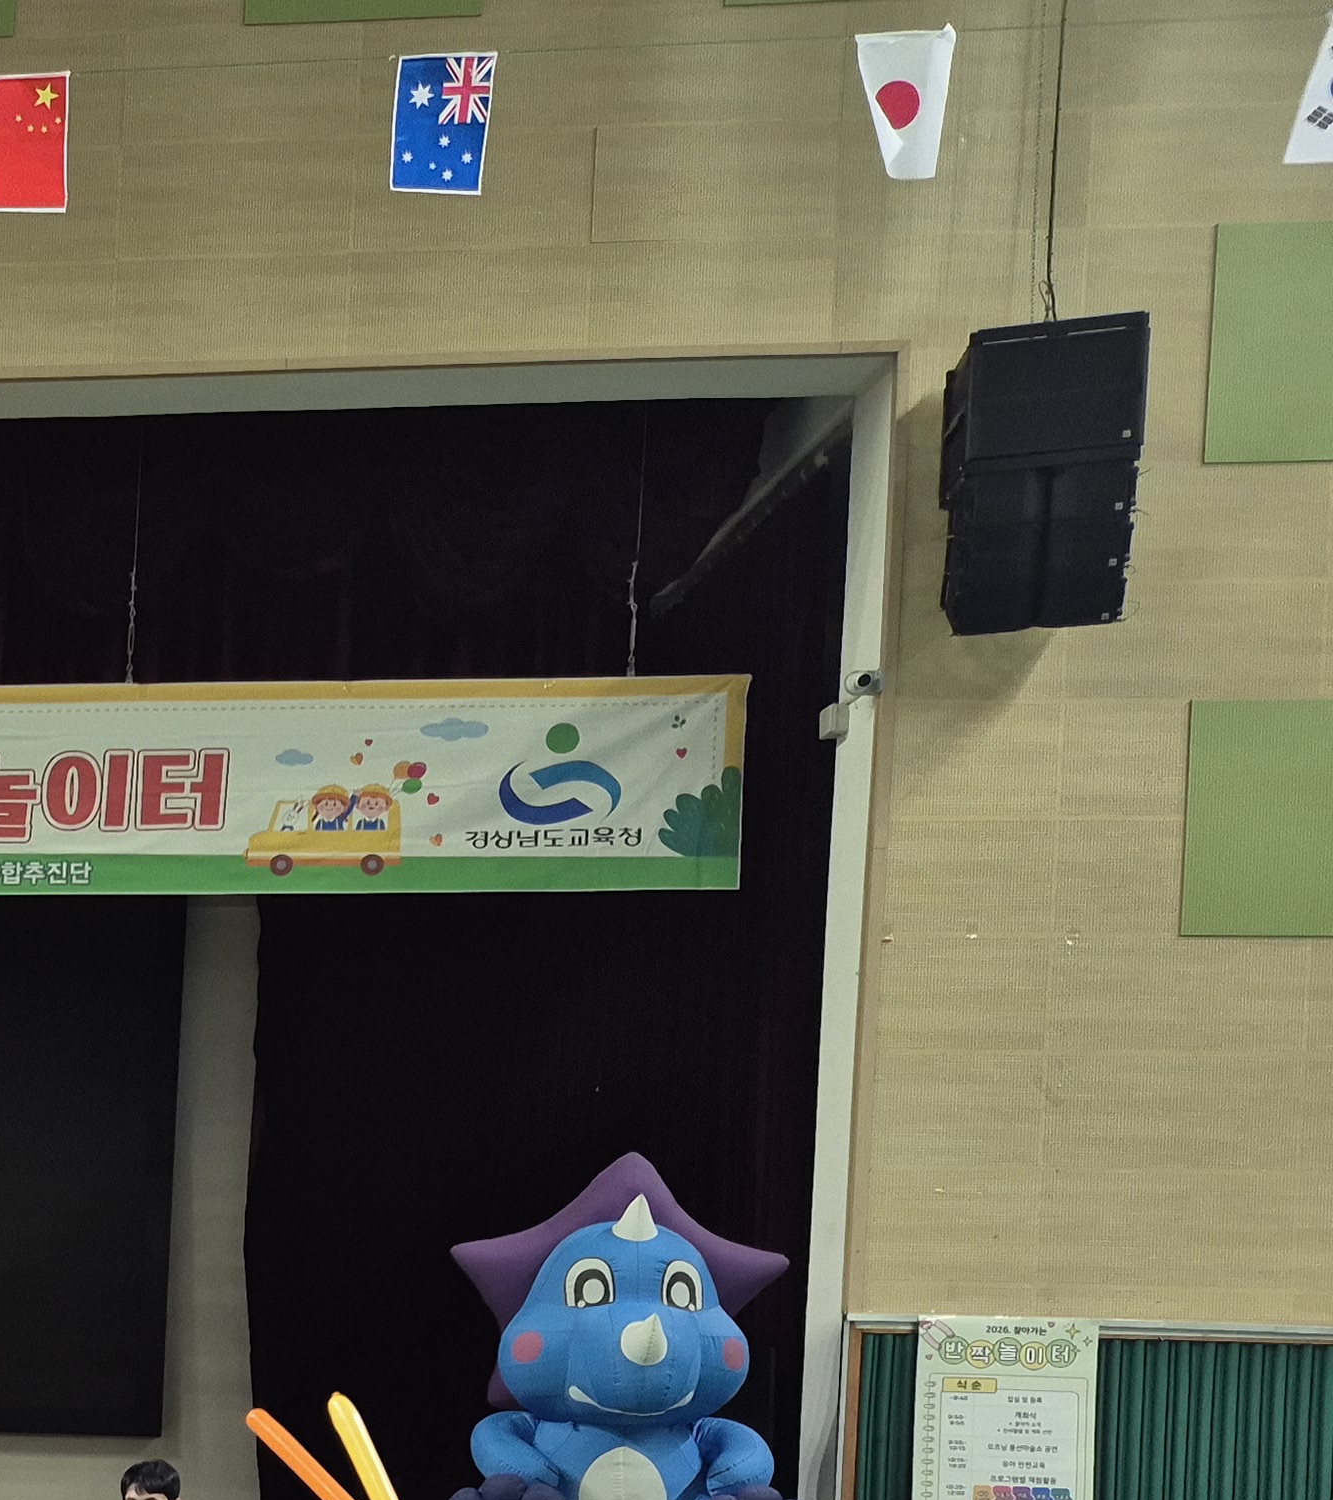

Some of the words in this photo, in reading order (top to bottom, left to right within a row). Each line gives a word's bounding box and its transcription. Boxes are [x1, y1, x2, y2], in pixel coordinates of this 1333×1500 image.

[465, 826, 642, 850] 경상남도교육청
[985, 1324, 1012, 1334] 2026.
[1013, 1325, 1048, 1337] 찾아가는
